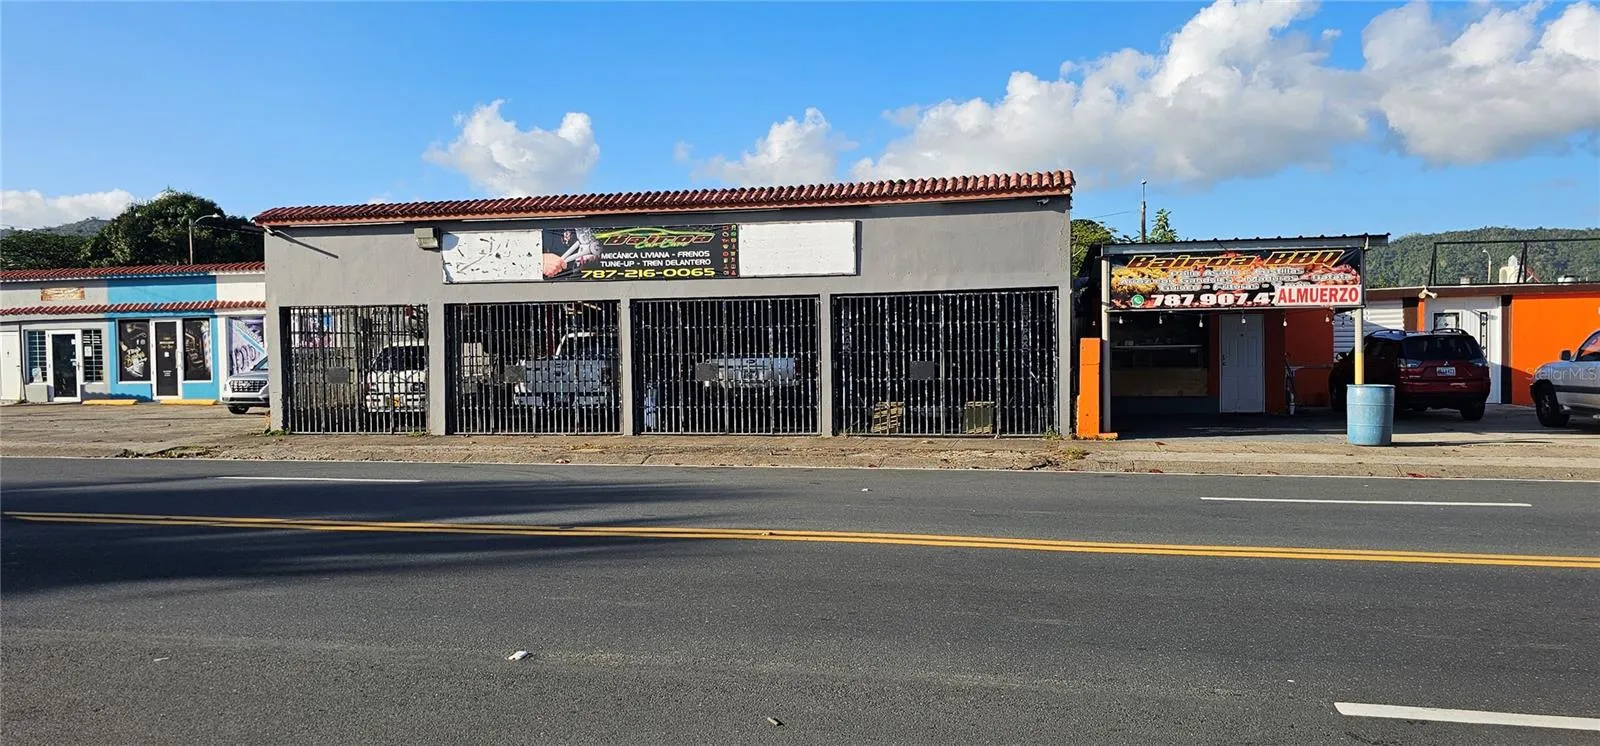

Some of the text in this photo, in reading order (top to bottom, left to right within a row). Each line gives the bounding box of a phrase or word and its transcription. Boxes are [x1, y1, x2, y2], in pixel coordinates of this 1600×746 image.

[640, 251, 670, 259] LIVIANA
[677, 250, 710, 258] FRENOS
[1126, 249, 1345, 268] Bairoa BBQ
[600, 260, 635, 268] TUNE-UP
[665, 259, 711, 267] DELANTERO
[580, 267, 716, 279] 787-216-0065
[1278, 285, 1359, 303] ALMUERZO
